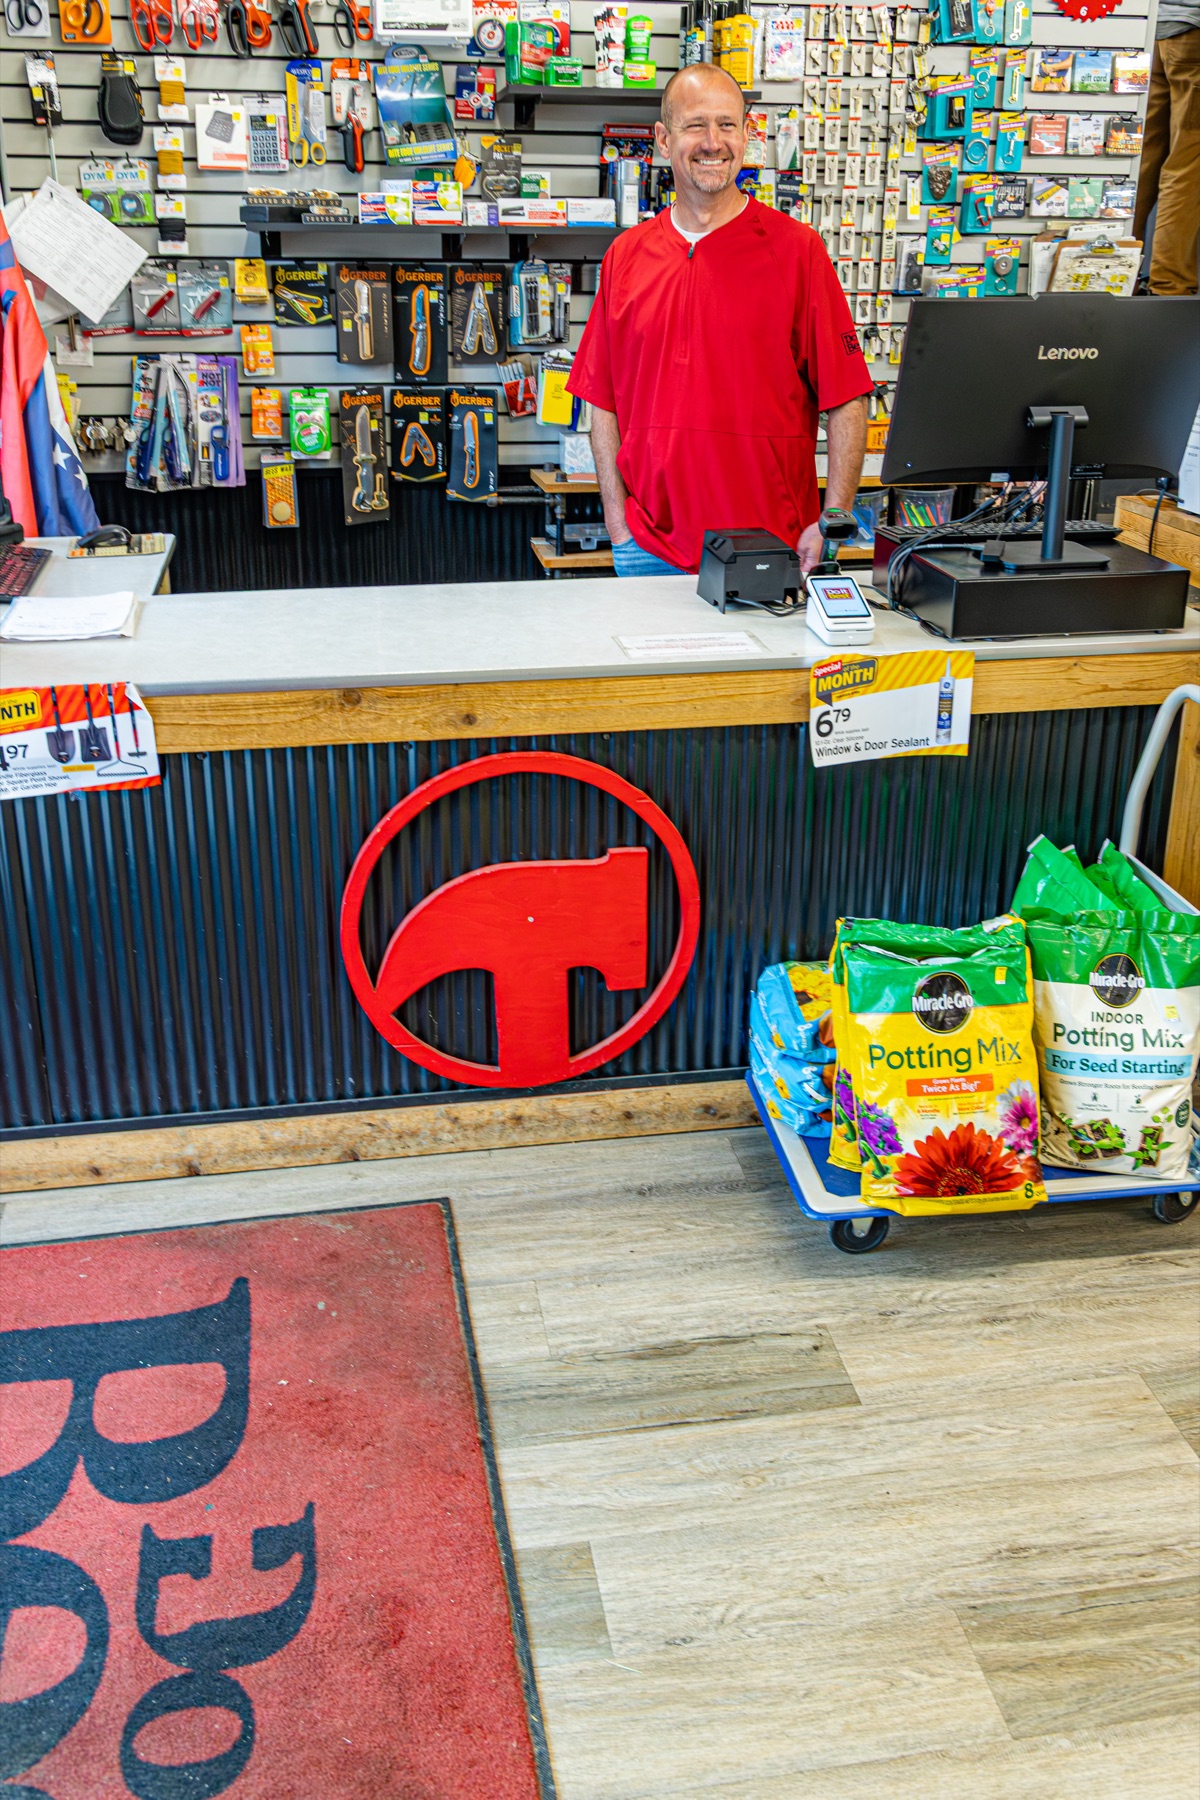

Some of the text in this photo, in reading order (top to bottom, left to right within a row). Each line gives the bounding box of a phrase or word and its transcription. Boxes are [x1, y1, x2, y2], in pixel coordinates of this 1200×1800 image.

[474, 7, 517, 17] rosman
[1080, 7, 1088, 16] 6
[1081, 73, 1107, 84] gift card
[493, 152, 504, 161] PAL
[998, 203, 1024, 213] gift card
[286, 271, 324, 281] GERBER
[349, 271, 387, 281] GERBER
[405, 272, 443, 282] GERBER
[465, 272, 503, 283] GERBER
[1038, 345, 1099, 360] Lenovo
[350, 395, 383, 406] GERBER
[403, 396, 441, 406] GERBER
[459, 396, 494, 407] GERBER
[814, 660, 842, 677] Special
[818, 667, 874, 692] MONTH
[816, 737, 930, 758] Window & Door Sealant
[1089, 971, 1146, 989] Miracle-Gro
[912, 993, 974, 1012] Miracle-Gro
[1091, 1011, 1144, 1024] INDOOR
[1053, 1022, 1185, 1052] Potting Mix
[869, 1036, 1022, 1073] Potting Mix
[1051, 1054, 1186, 1076] For Seed Starting
[921, 1084, 948, 1093] Twice
[950, 1083, 960, 1091] As
[1078, 1081, 1102, 1090] Stronger
[1024, 1182, 1034, 1199] 8
